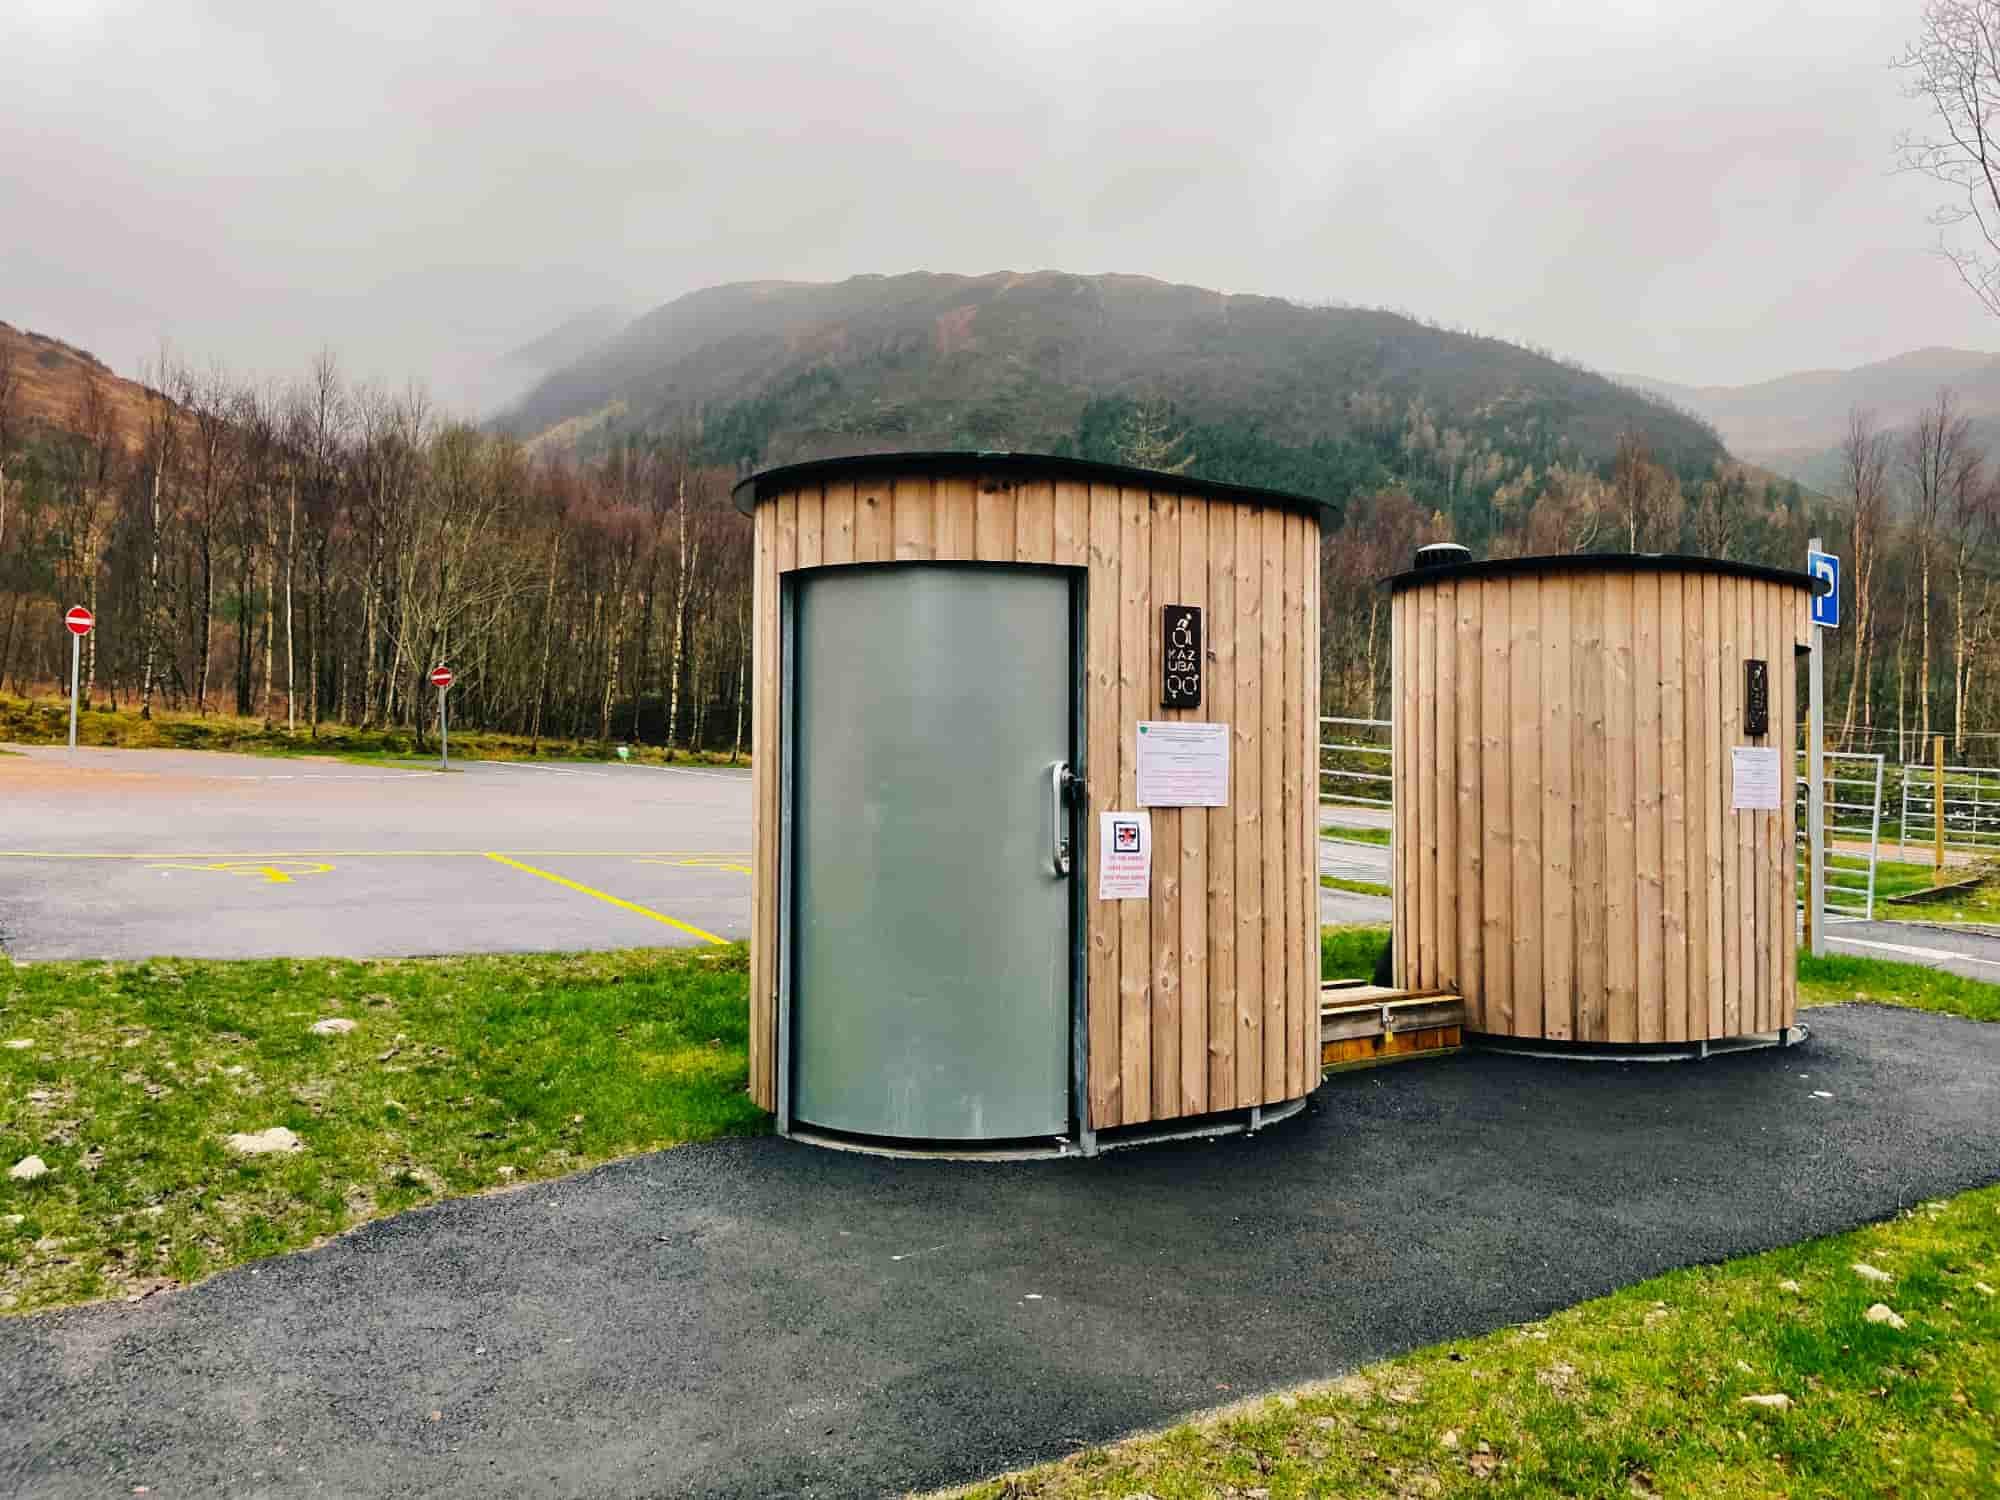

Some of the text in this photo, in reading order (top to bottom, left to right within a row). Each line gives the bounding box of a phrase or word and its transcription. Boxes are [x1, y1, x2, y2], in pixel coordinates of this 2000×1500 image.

[1816, 560, 1833, 617] P
[1168, 649, 1196, 661] KAZ
[1168, 661, 1196, 672] UBA
